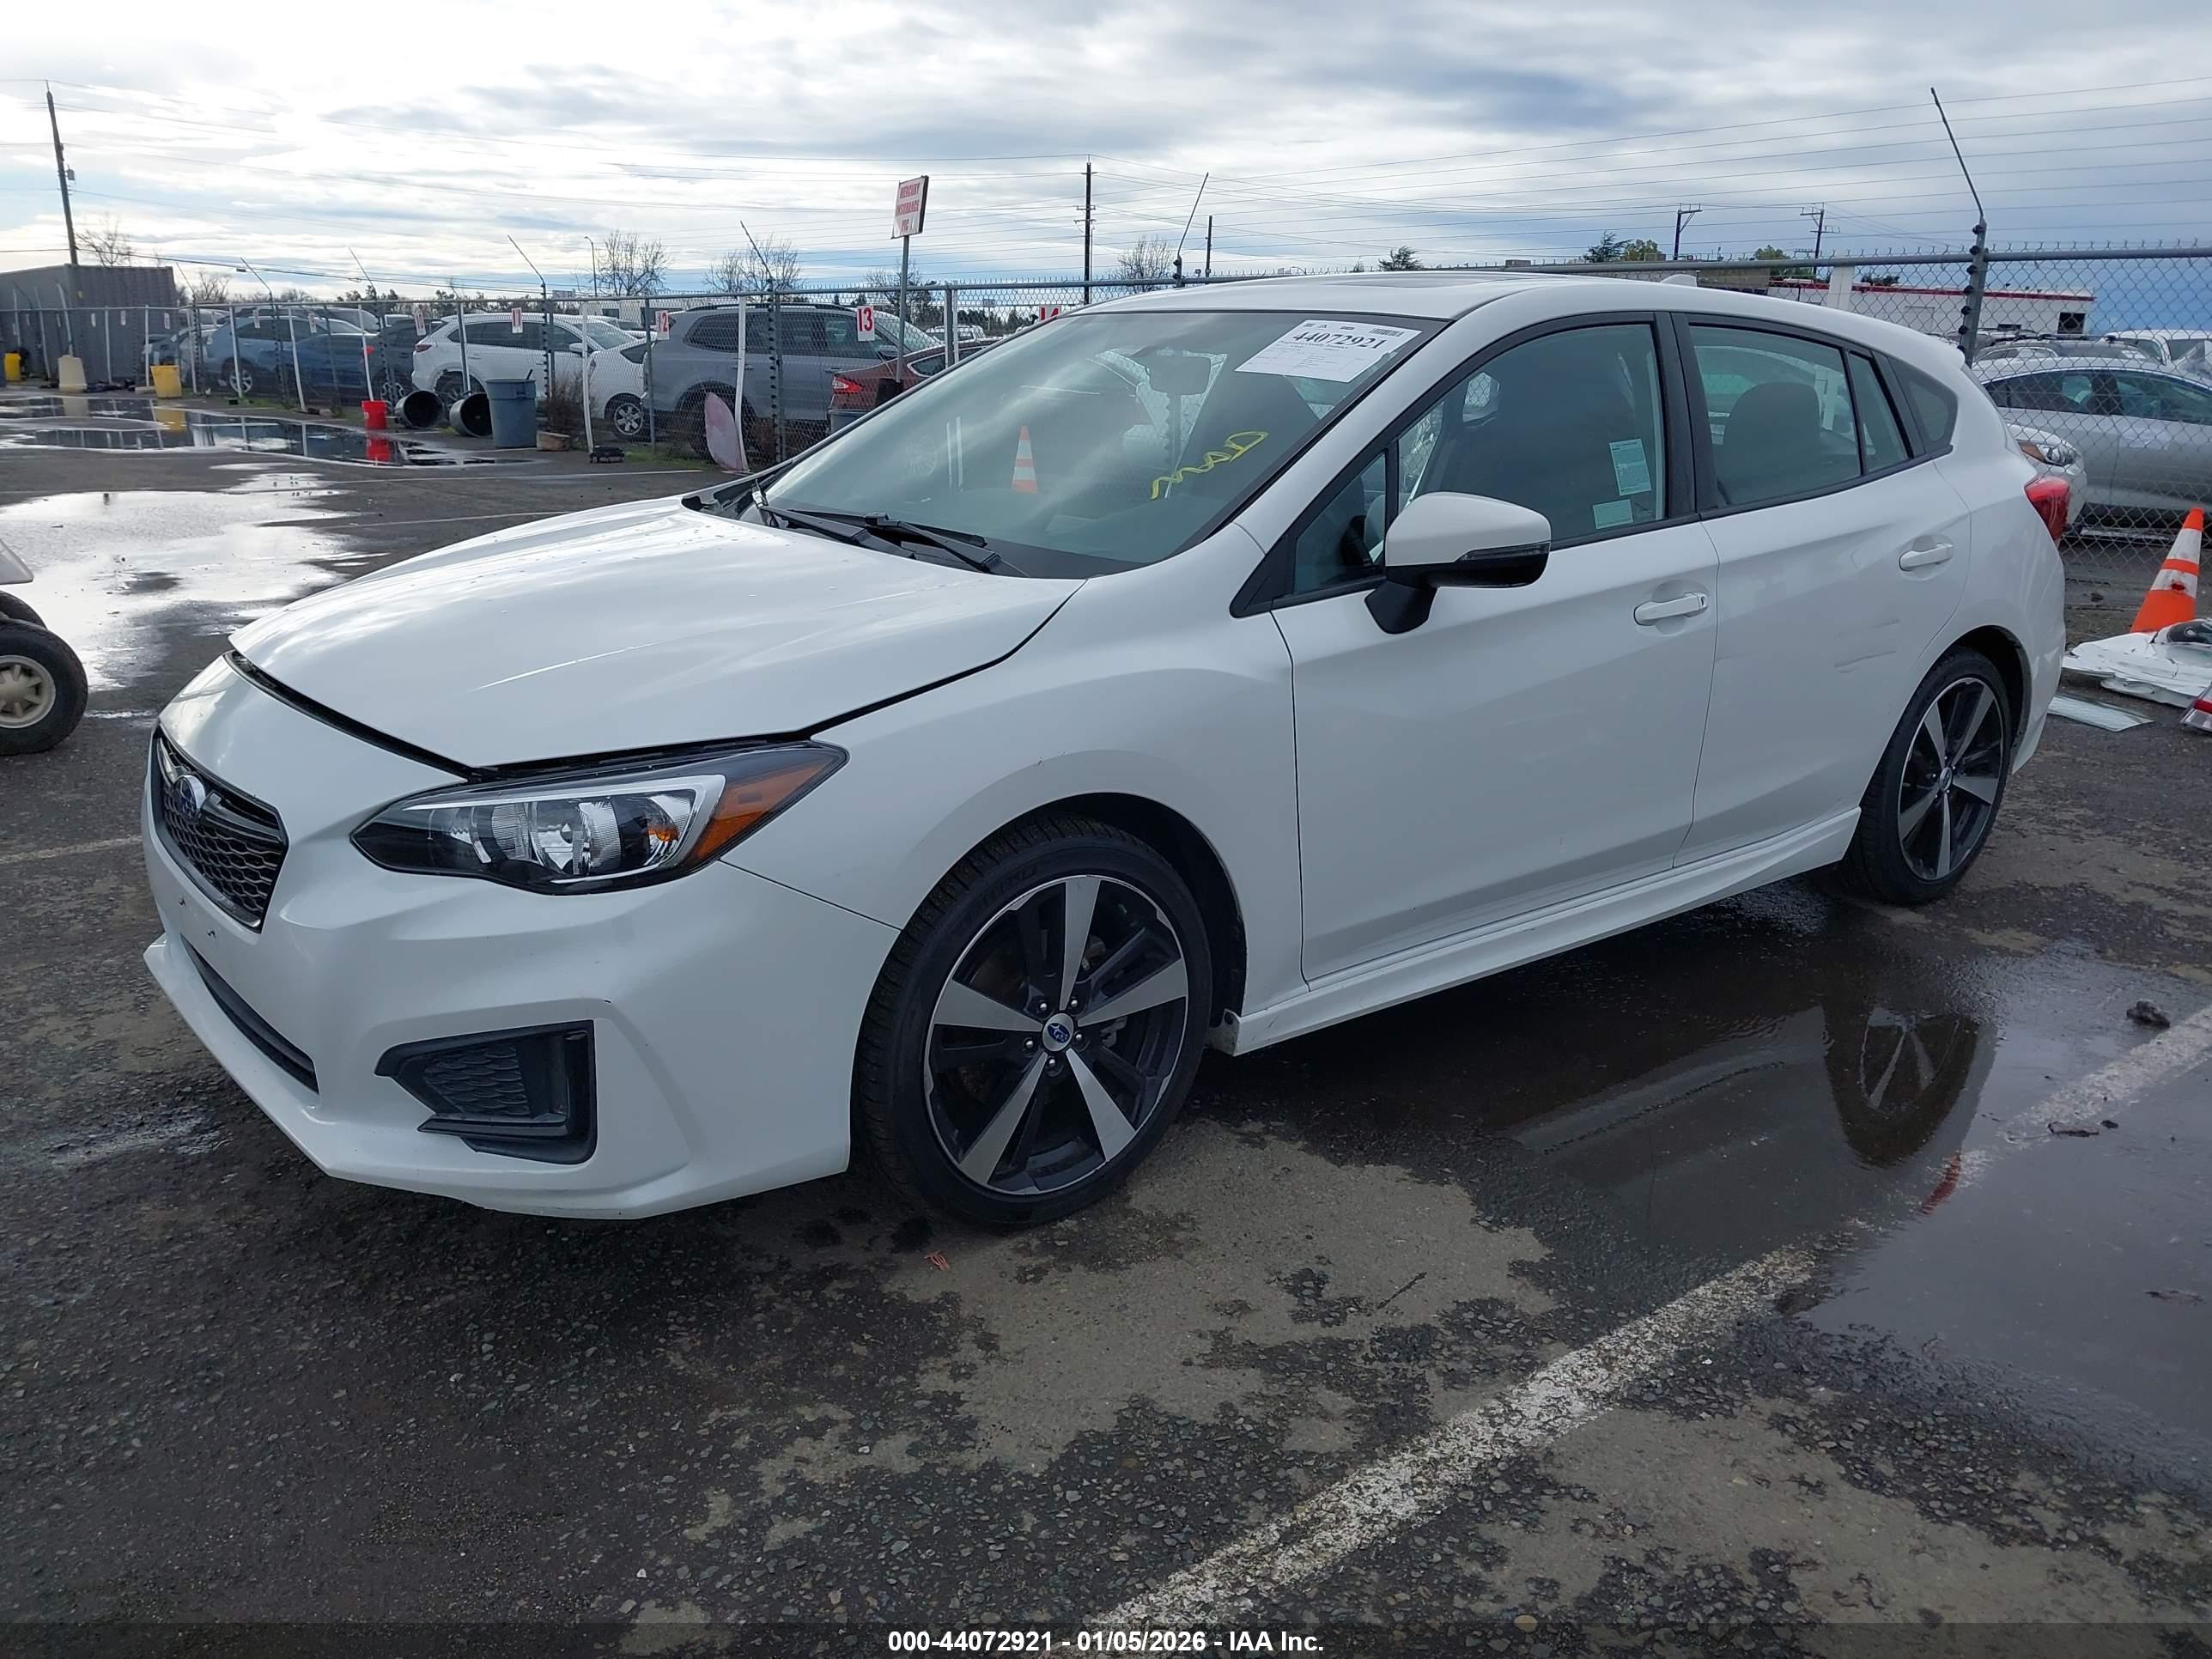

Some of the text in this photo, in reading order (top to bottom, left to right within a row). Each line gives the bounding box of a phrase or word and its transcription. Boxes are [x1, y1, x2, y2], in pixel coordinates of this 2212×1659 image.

[658, 311, 668, 332] 12
[859, 307, 873, 331] 13
[1291, 331, 1388, 349] 44072921
